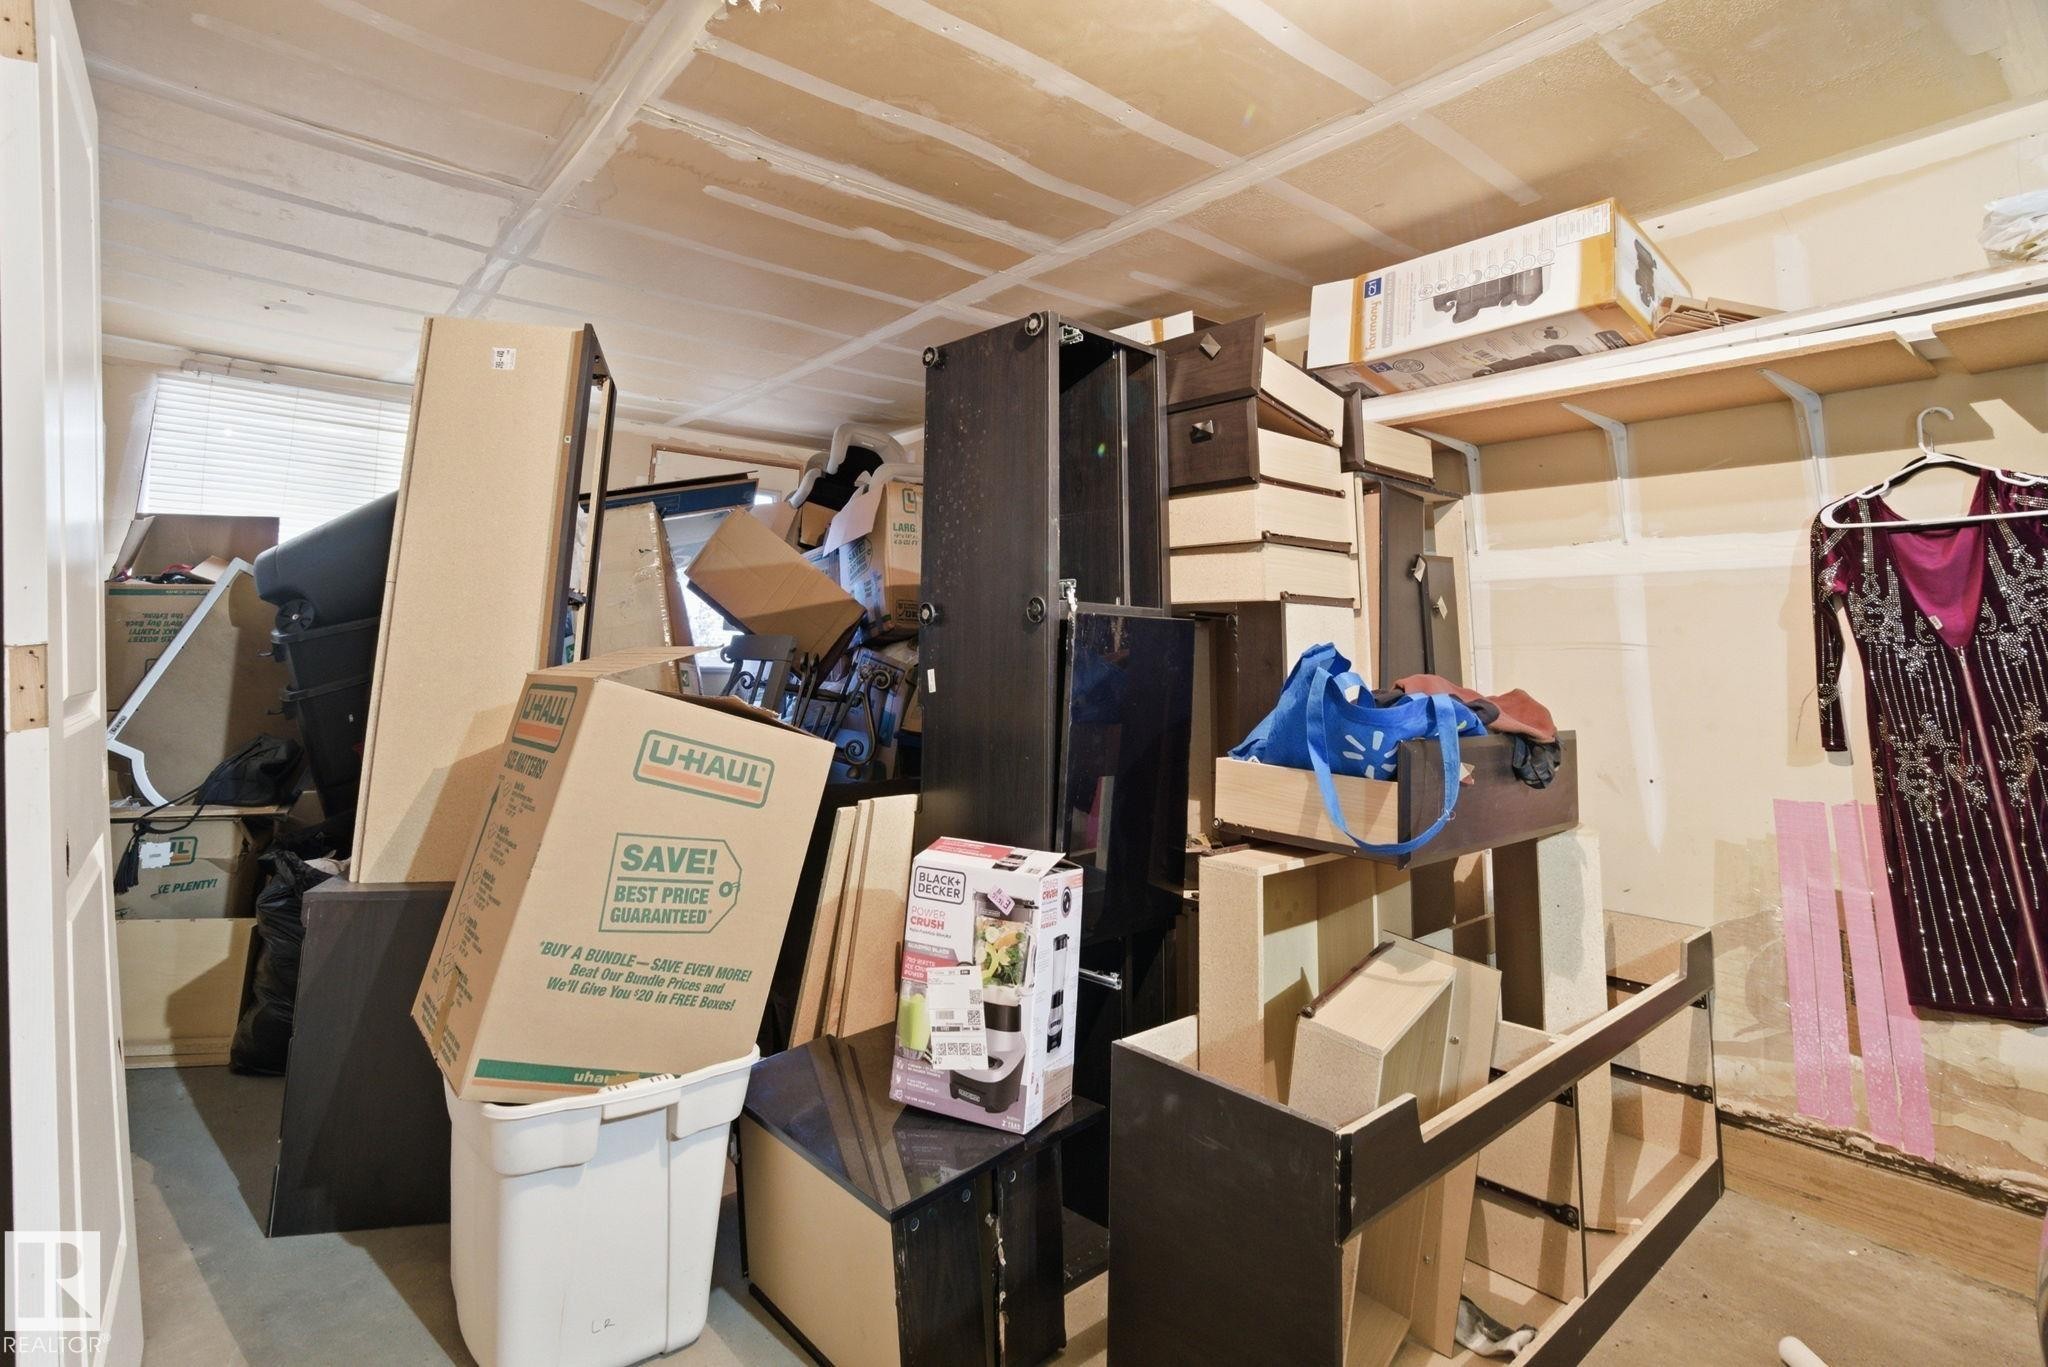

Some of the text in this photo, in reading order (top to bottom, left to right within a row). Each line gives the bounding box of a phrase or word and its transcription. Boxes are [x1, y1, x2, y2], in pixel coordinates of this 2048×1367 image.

[1366, 300, 1381, 351] harmony
[893, 522, 917, 532] LARG
[620, 844, 718, 875] SAVE!
[172, 878, 218, 893] PLENTY!
[919, 872, 961, 887] BLACK+
[613, 885, 709, 905] BEST PRICE
[918, 883, 960, 898] DECKER
[911, 905, 945, 919] POWER
[910, 916, 945, 930] CRUSH
[570, 946, 583, 960] A
[683, 963, 714, 978] EVEN
[715, 966, 753, 982] MORE!
[569, 963, 726, 994] Beat Our Bundle Prices and
[546, 976, 736, 1011] We'll Give You $20 in FREE Boxes!
